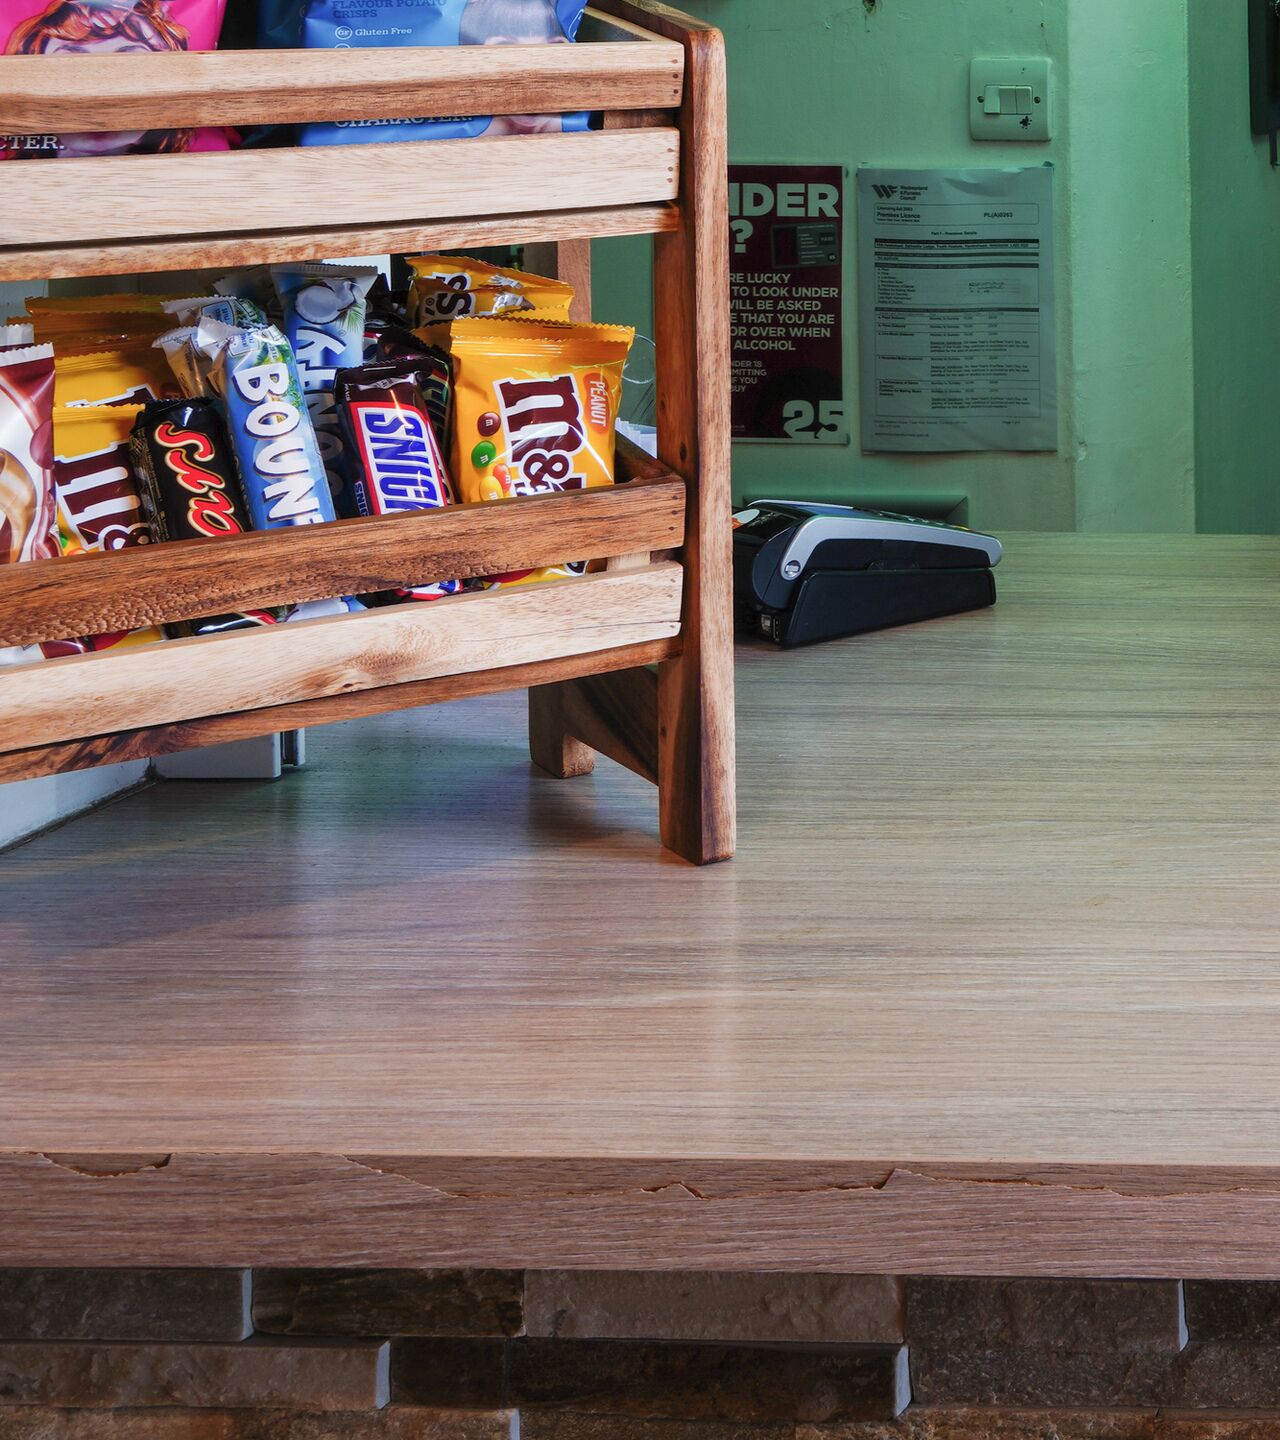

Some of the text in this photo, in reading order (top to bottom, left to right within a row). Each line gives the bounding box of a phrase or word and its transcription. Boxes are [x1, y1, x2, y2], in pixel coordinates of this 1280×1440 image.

[332, 9, 378, 20] CRISPS
[354, 26, 413, 37] Gluten Free
[747, 273, 791, 284] LUCKY
[732, 286, 839, 298] TO LOOK UNDER
[757, 300, 822, 311] BE ASKED
[740, 313, 836, 324] THAT YOU ARE
[750, 327, 786, 337] OVER
[789, 327, 831, 338] WHEN
[733, 340, 797, 351] ALCOHOL
[740, 377, 758, 385] YOU
[588, 380, 607, 427] PEANUT
[782, 399, 845, 439] 25
